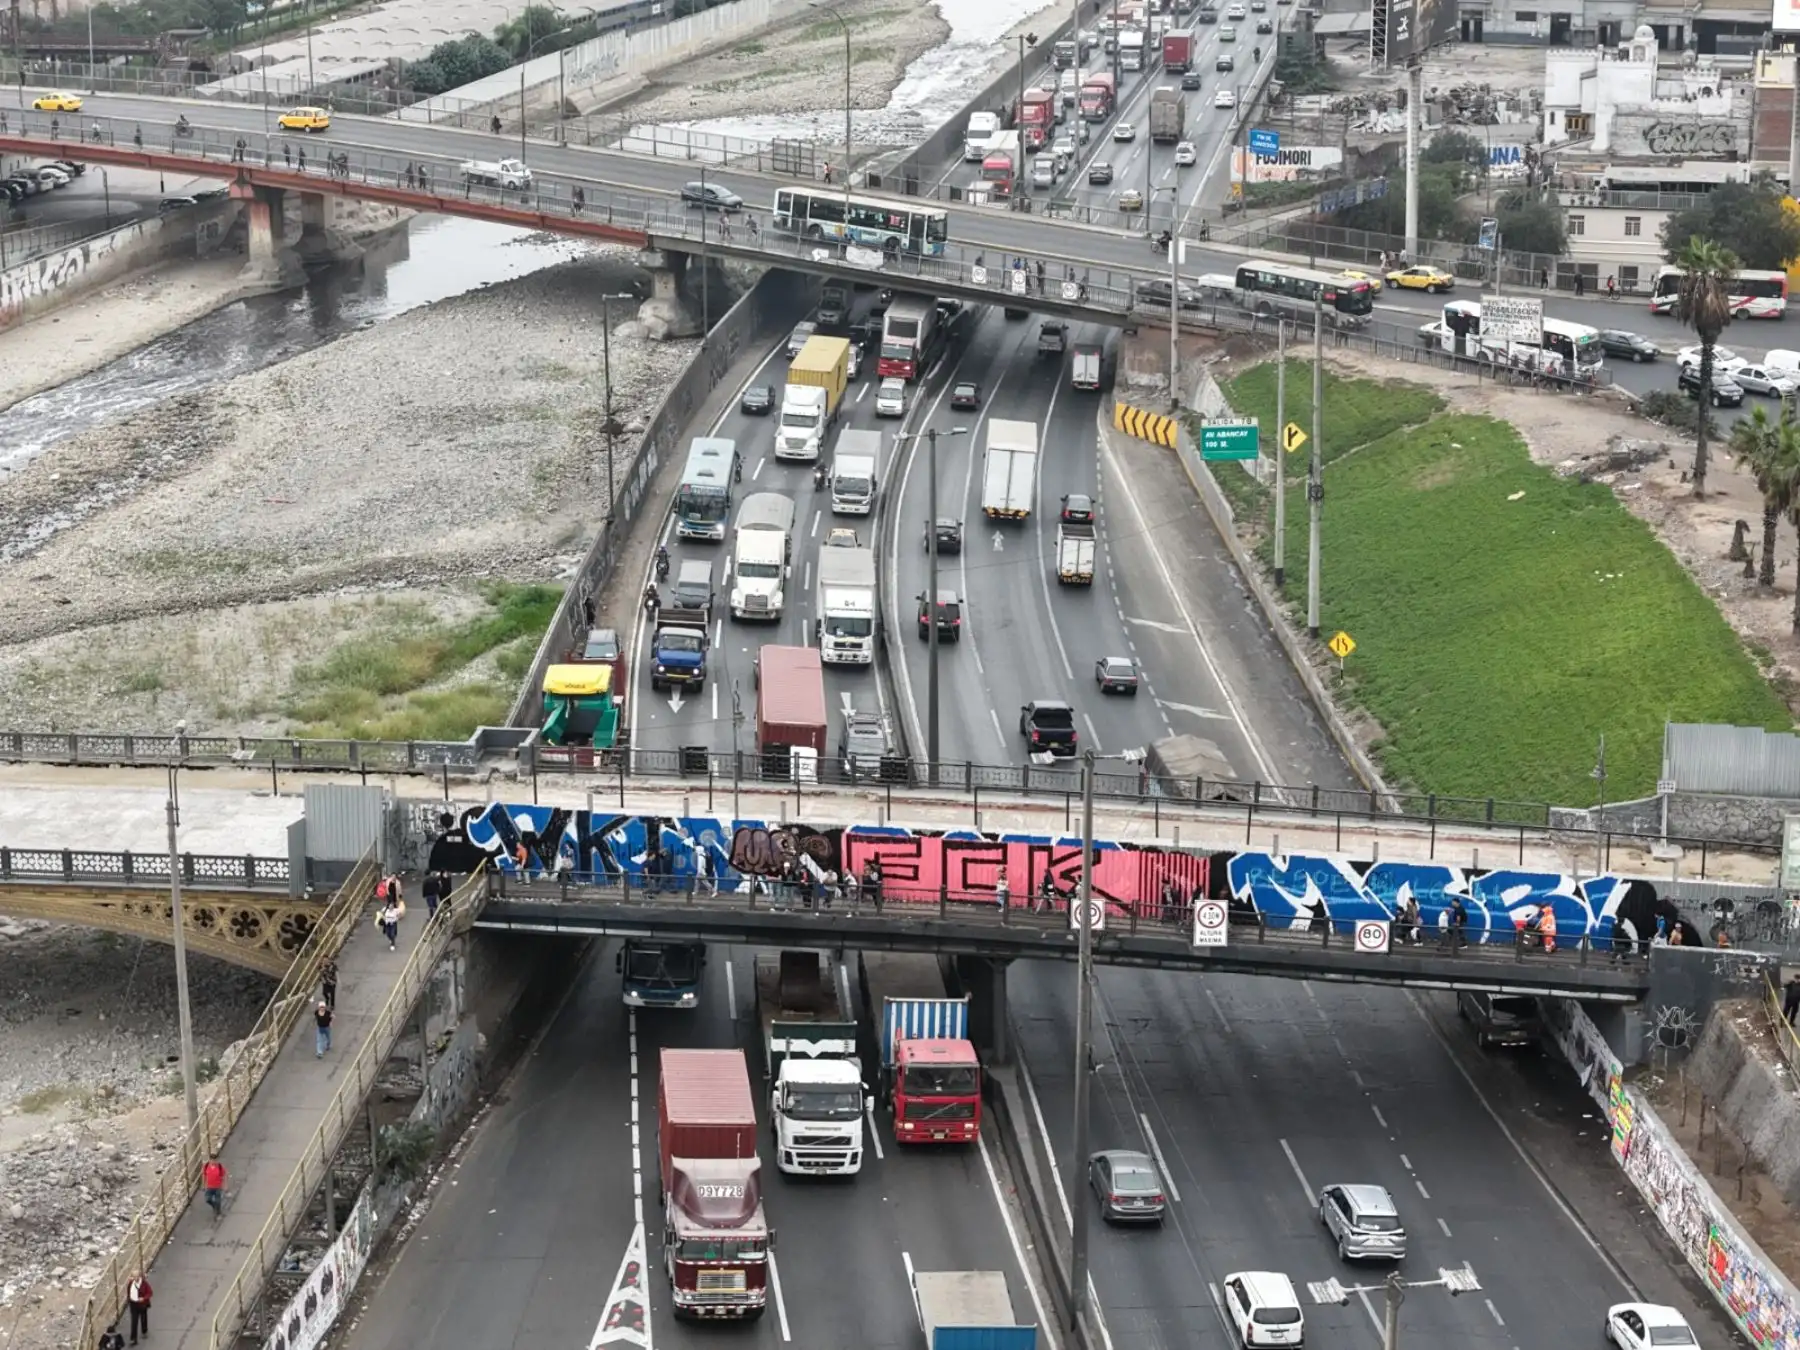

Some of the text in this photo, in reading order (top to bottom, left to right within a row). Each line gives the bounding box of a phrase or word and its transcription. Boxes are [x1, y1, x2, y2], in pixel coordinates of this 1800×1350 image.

[1256, 150, 1312, 165] FUJIMORI
[1216, 430, 1249, 438] ABANCAY
[1363, 928, 1381, 939] 80
